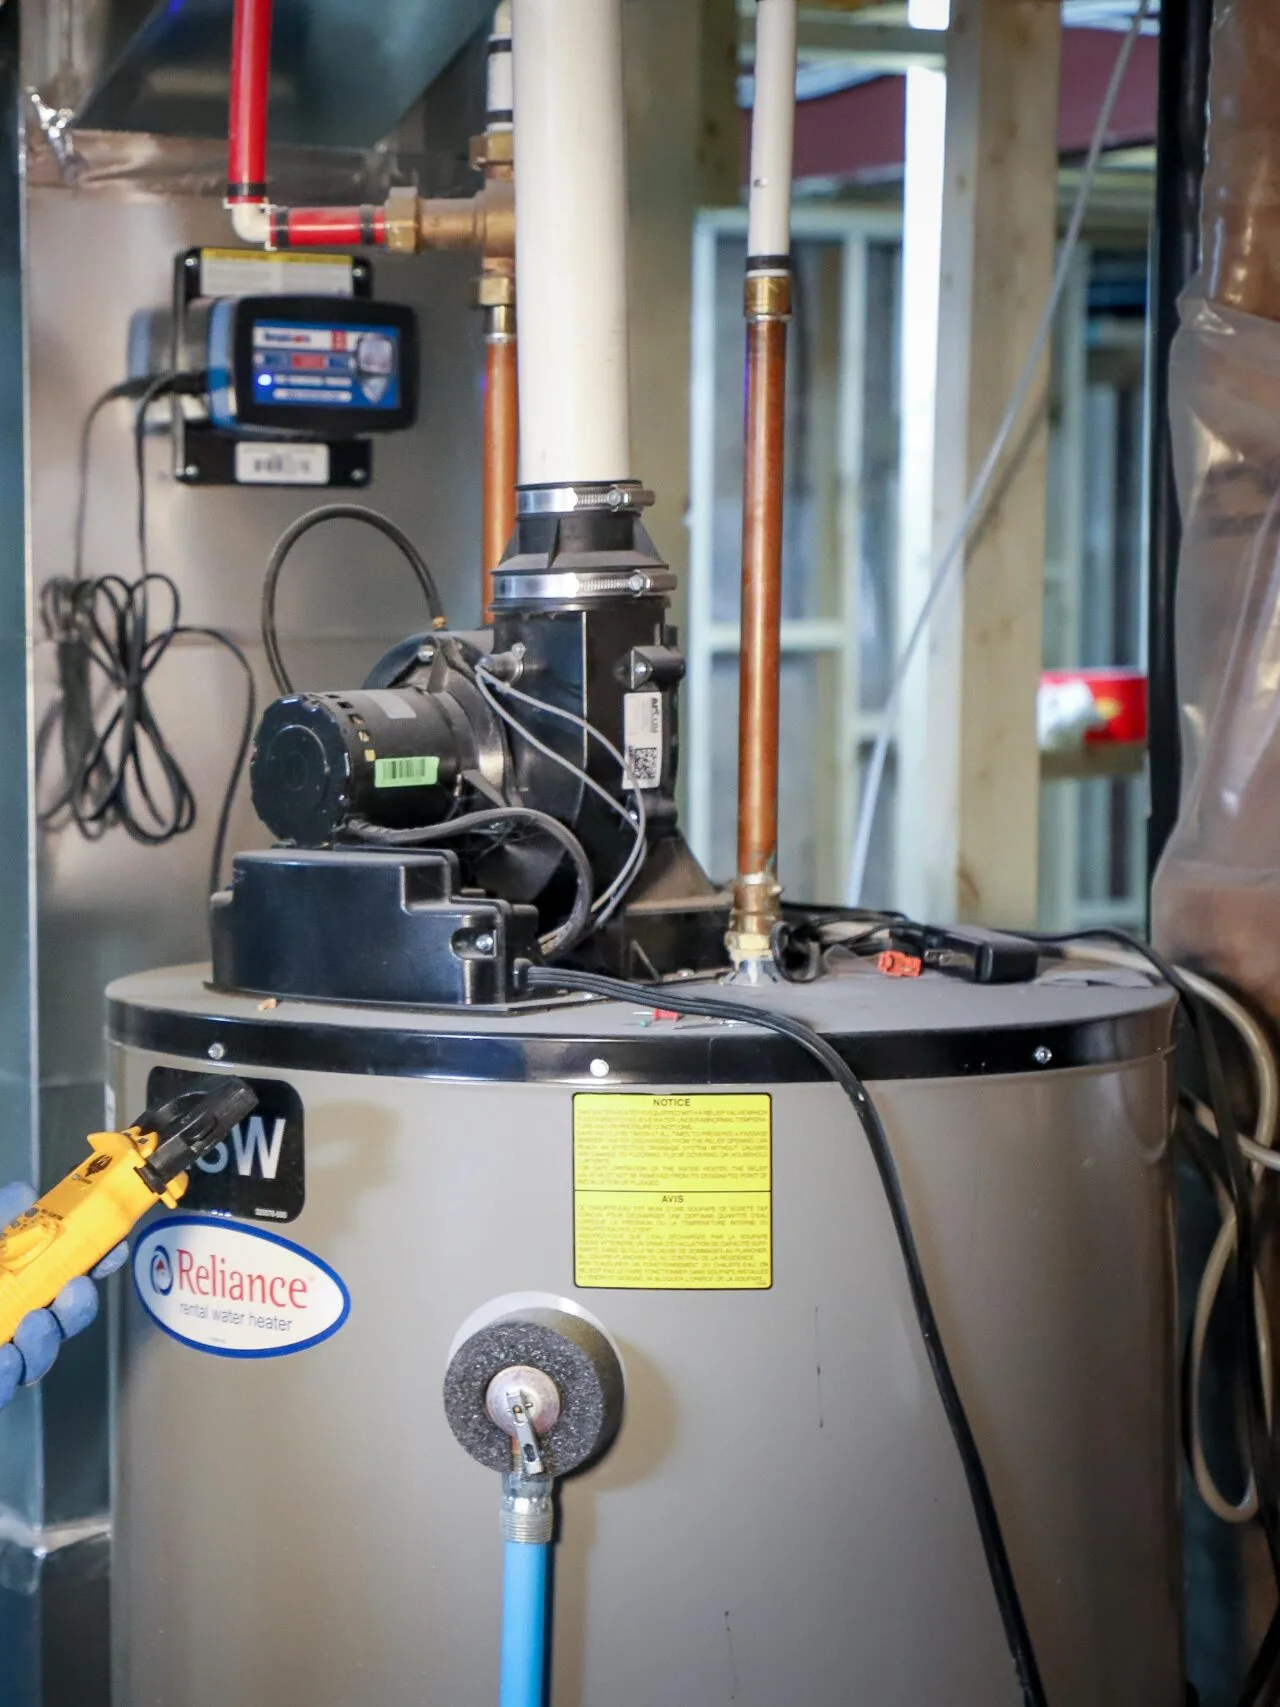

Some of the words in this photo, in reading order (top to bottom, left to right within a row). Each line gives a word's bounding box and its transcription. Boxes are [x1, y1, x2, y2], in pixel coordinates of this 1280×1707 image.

[653, 1098, 691, 1107] NOTICE
[661, 1195, 684, 1203] AVIS
[176, 1248, 308, 1309] Reliance
[180, 1302, 208, 1319] rental
[212, 1309, 245, 1326] water
[249, 1313, 293, 1332] heater
